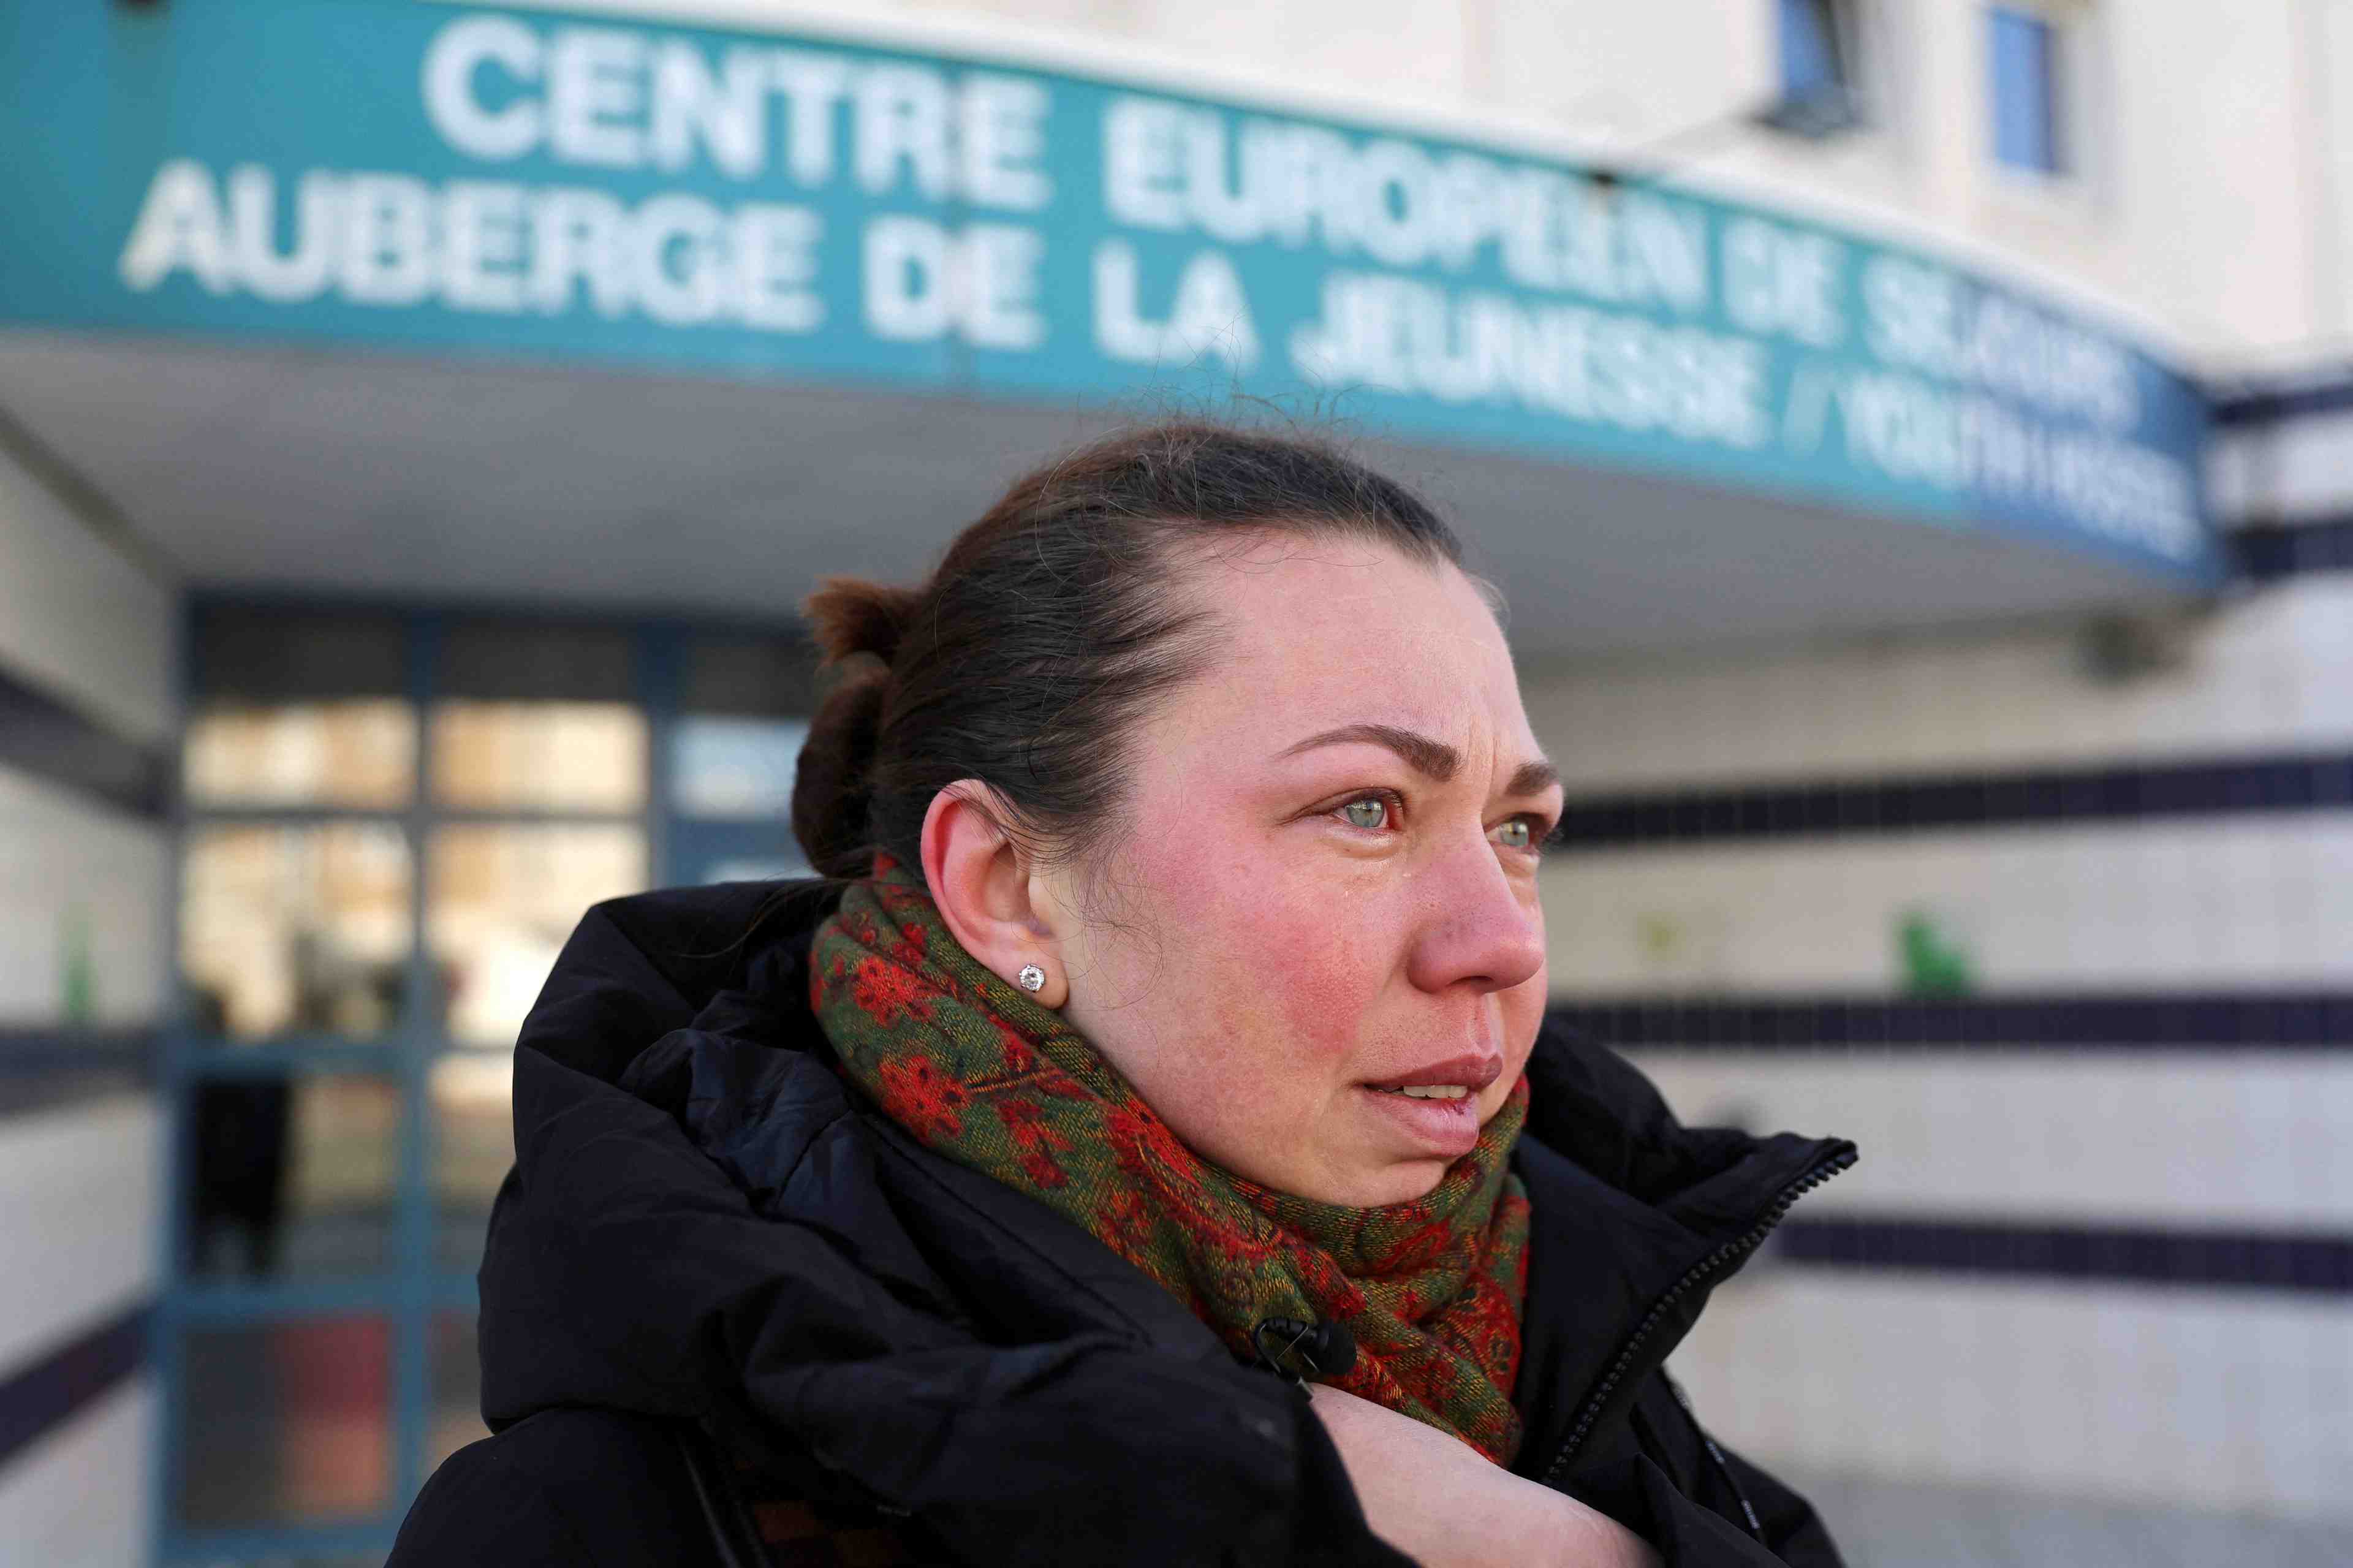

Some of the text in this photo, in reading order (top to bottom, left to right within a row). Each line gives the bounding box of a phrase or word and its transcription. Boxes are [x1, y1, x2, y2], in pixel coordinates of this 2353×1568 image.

[122, 160, 822, 331] AUBERGE
[865, 216, 1044, 350] DE
[1093, 241, 1257, 368] LA
[1290, 268, 1771, 450] JEUNESSE
[423, 15, 1050, 210] CENTRE
[1722, 213, 1843, 347] DE
